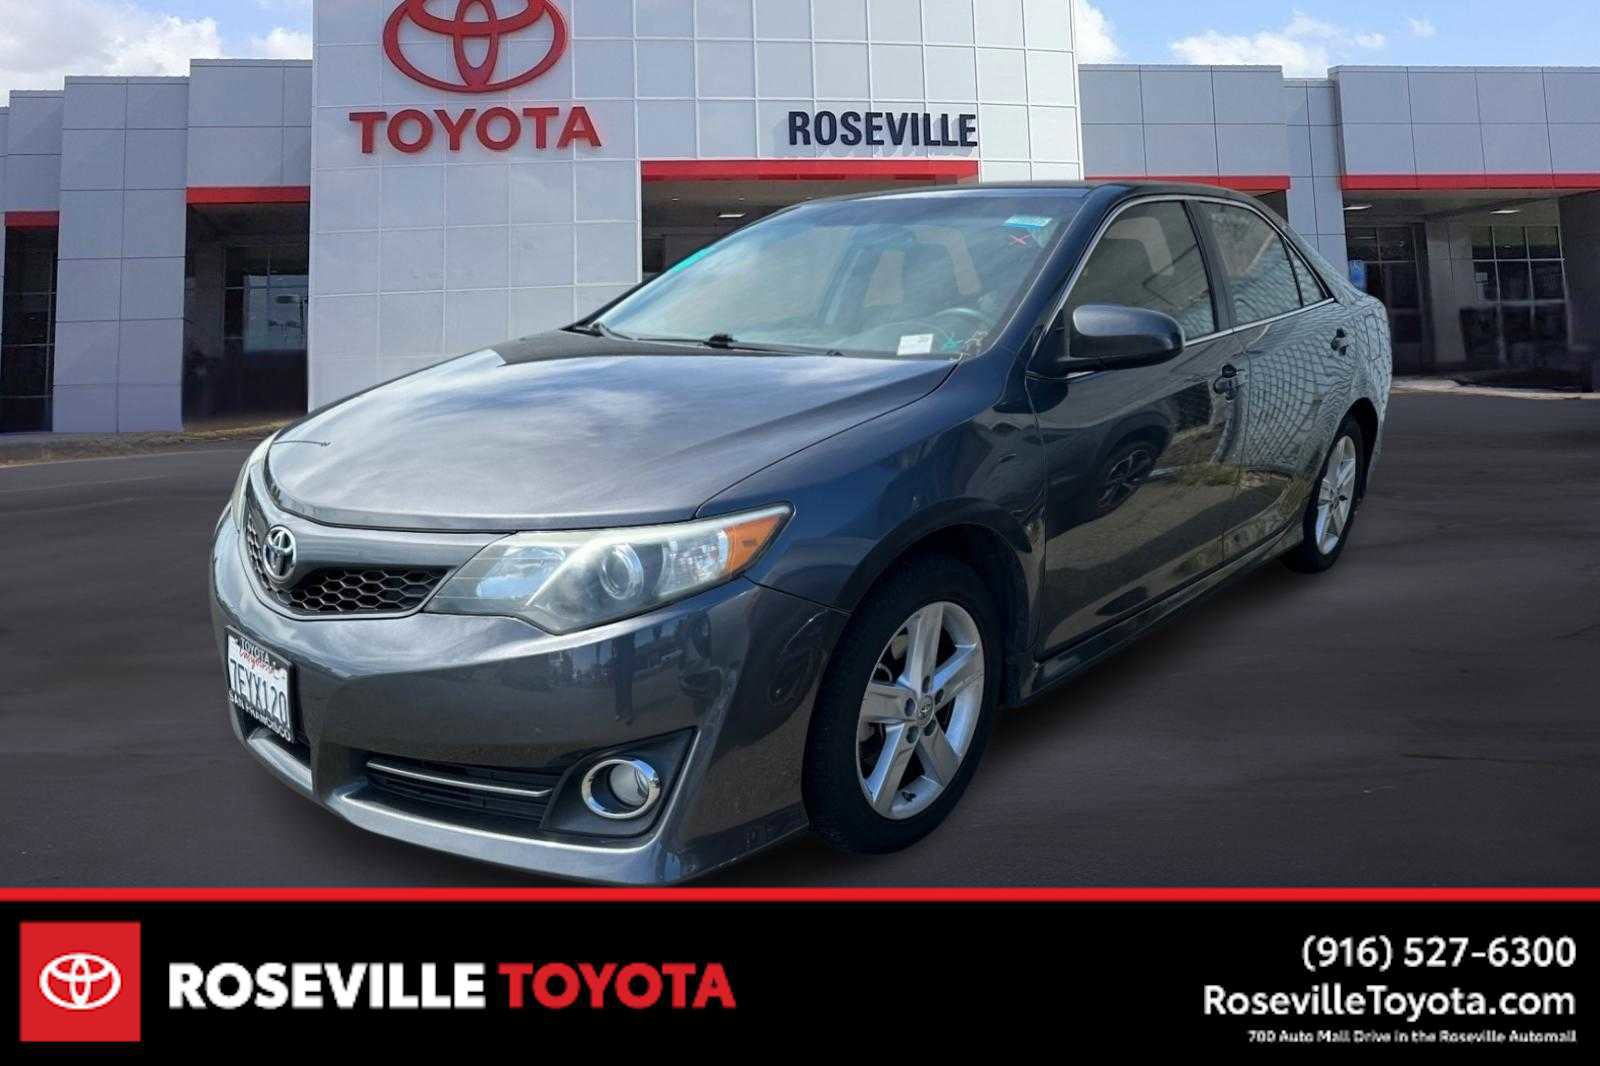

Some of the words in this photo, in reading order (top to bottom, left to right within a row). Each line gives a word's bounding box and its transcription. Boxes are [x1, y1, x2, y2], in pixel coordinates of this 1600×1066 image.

[349, 106, 603, 154] TOYOTA
[788, 111, 978, 147] ROSEVILLE
[240, 638, 271, 665] TOYOTA
[230, 658, 290, 728] 7EYX120
